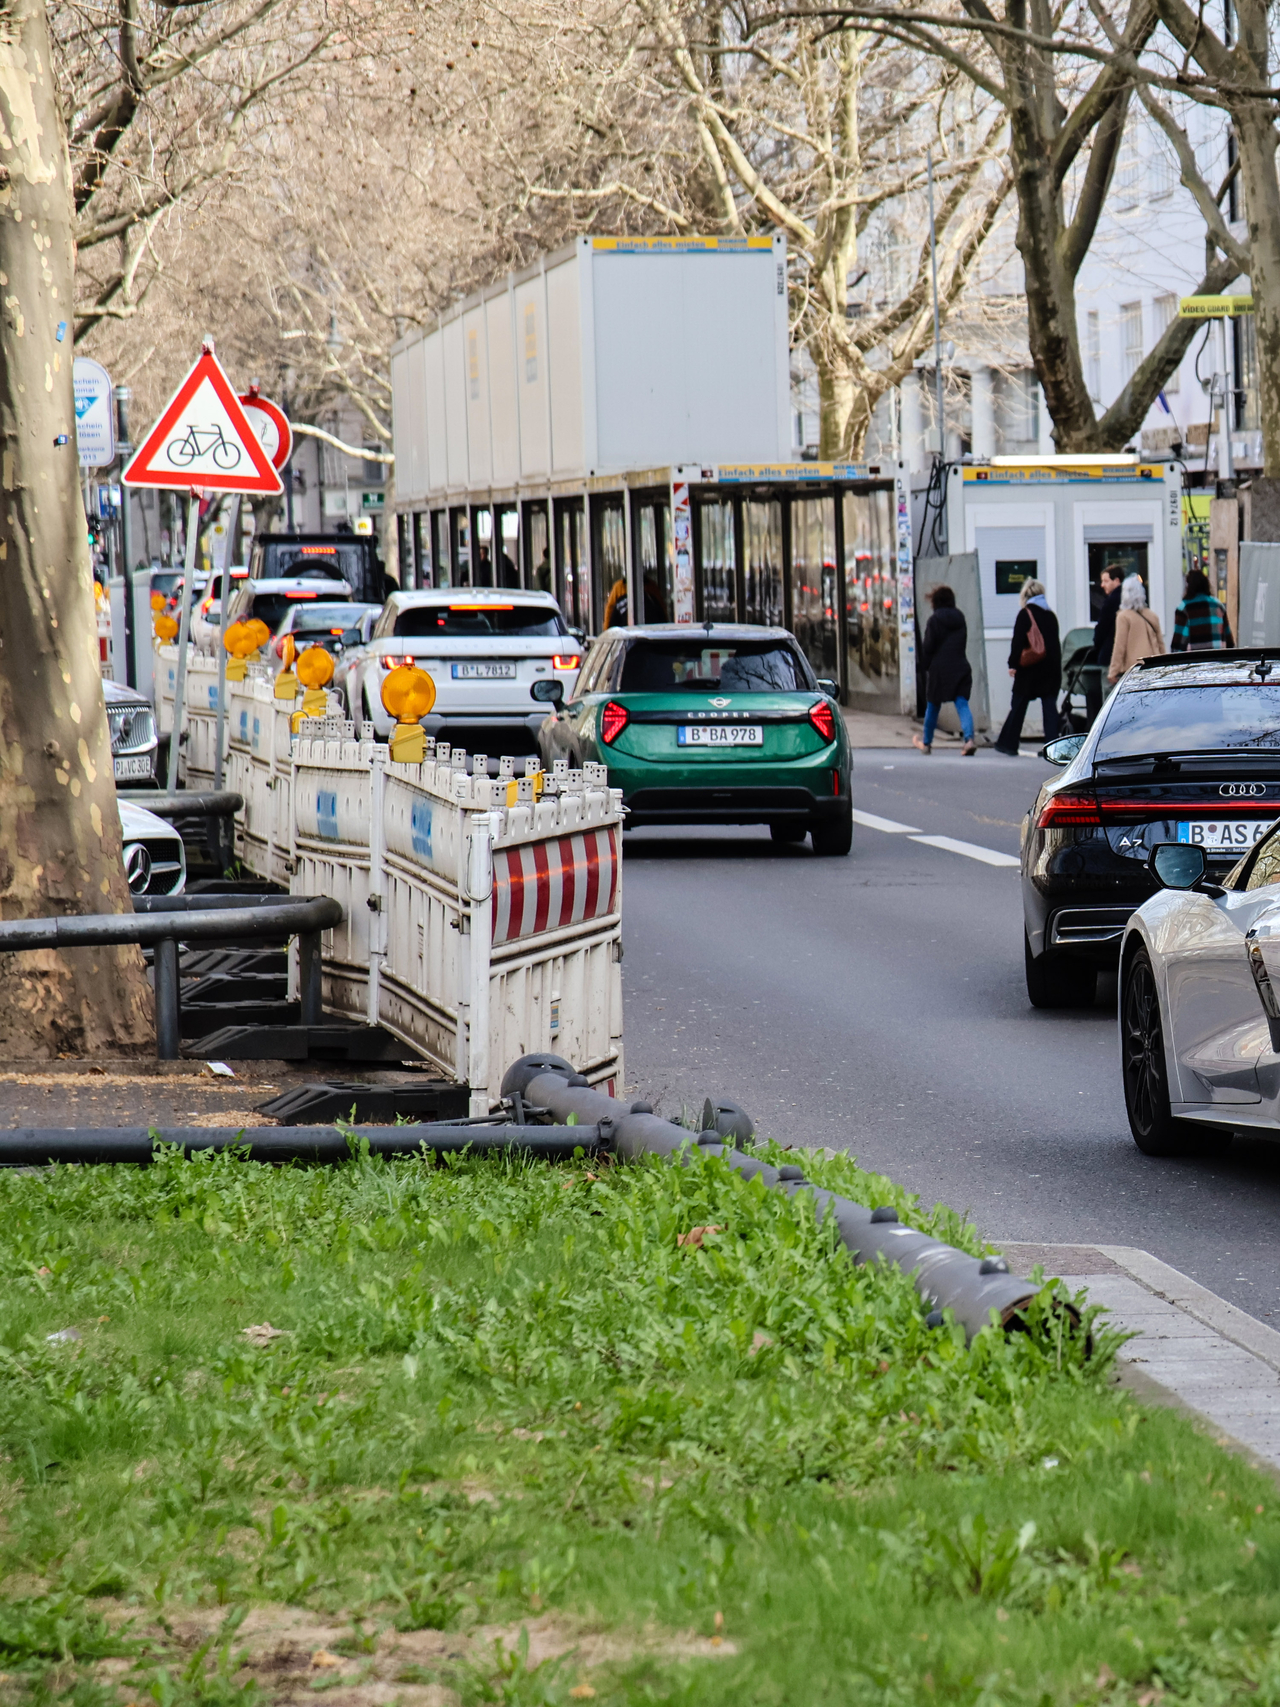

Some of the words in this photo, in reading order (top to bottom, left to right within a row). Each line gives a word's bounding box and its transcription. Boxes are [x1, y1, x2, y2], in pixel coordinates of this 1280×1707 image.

[616, 240, 649, 249] Einfach
[652, 240, 672, 248] alles
[719, 467, 755, 477] Einfach
[759, 467, 782, 476] alles
[786, 467, 820, 475] mieten
[990, 470, 1026, 479] Einfach
[1029, 470, 1052, 478] alles
[485, 663, 511, 676] 7812
[691, 728, 701, 741] B
[710, 728, 728, 741] BA
[731, 728, 756, 741] 978
[1191, 824, 1205, 844] B
[1220, 824, 1248, 845] AS
[1119, 836, 1143, 847] A7
